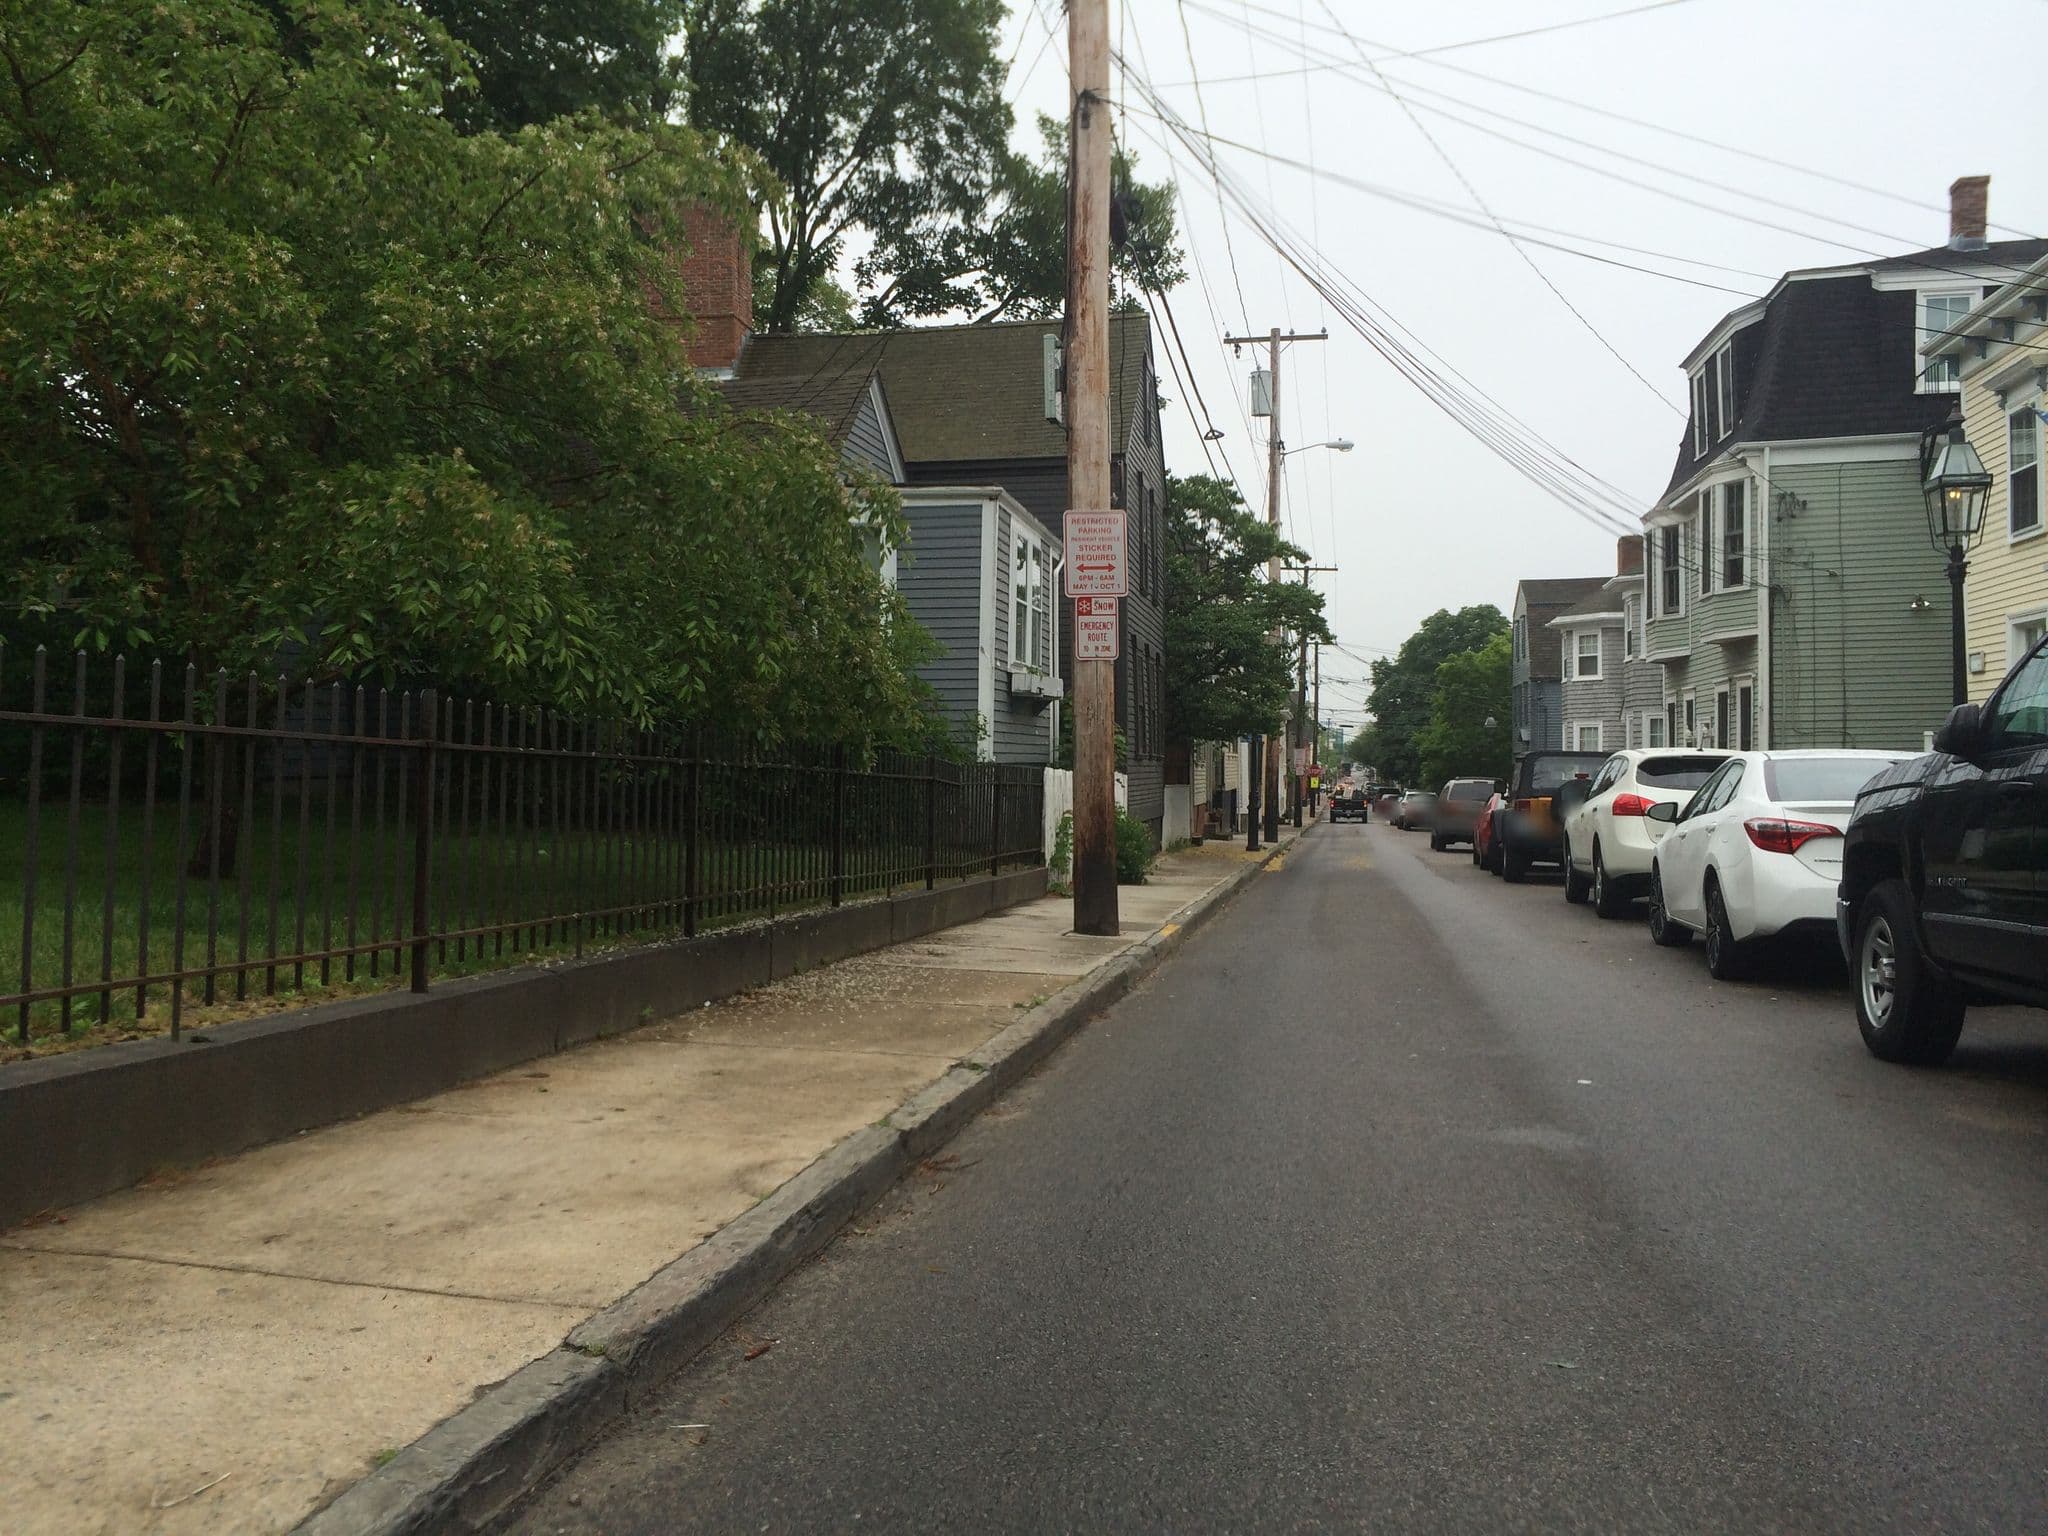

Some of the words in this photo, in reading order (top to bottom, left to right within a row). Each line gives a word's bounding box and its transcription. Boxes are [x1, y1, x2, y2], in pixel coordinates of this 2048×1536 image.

[1071, 517, 1119, 525] RESTRICTED
[1078, 544, 1113, 552] STICKER
[1093, 602, 1114, 611] SNOW
[1080, 621, 1114, 631] EMERGENCY
[1087, 633, 1108, 642] ROUTE
